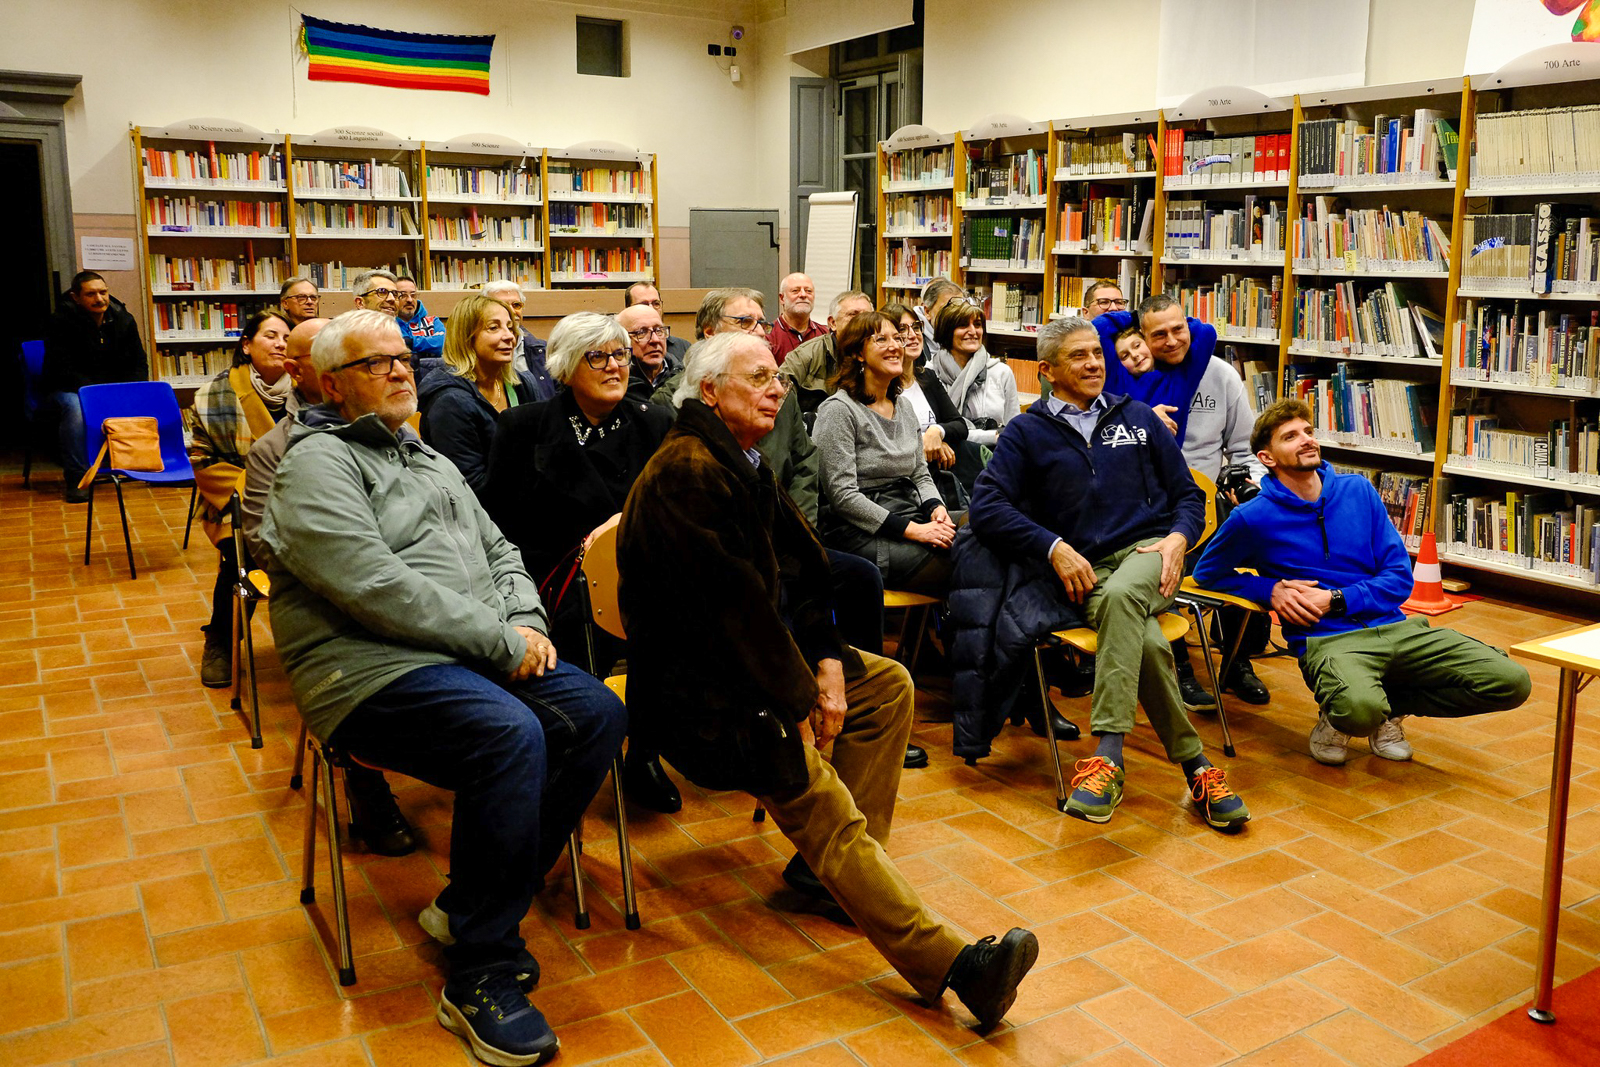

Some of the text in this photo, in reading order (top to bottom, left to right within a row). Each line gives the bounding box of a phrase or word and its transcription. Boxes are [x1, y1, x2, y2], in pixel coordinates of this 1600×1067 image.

[1544, 59, 1581, 70] 700 Arte
[1220, 98, 1231, 106] Arte
[1192, 391, 1216, 408] Afa
